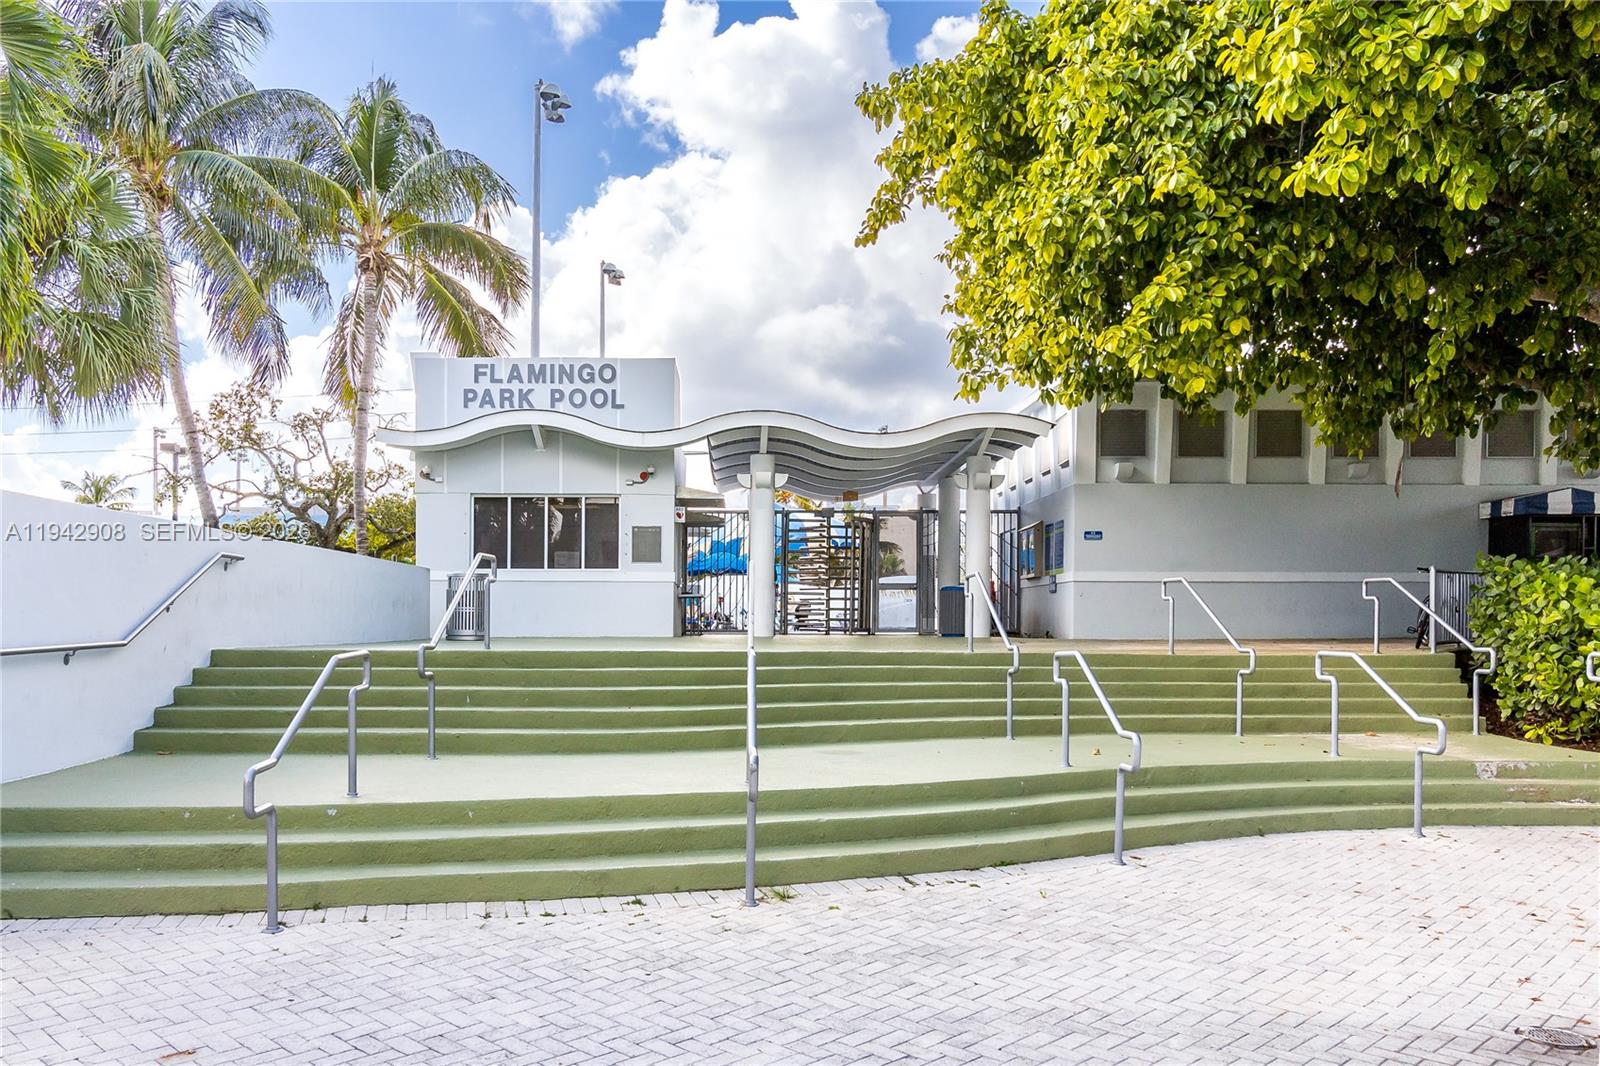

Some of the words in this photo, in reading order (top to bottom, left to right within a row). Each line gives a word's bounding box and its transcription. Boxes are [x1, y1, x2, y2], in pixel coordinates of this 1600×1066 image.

[473, 363, 617, 384] FLAMINGO
[463, 388, 535, 409] PARK
[550, 388, 625, 409] POOL
